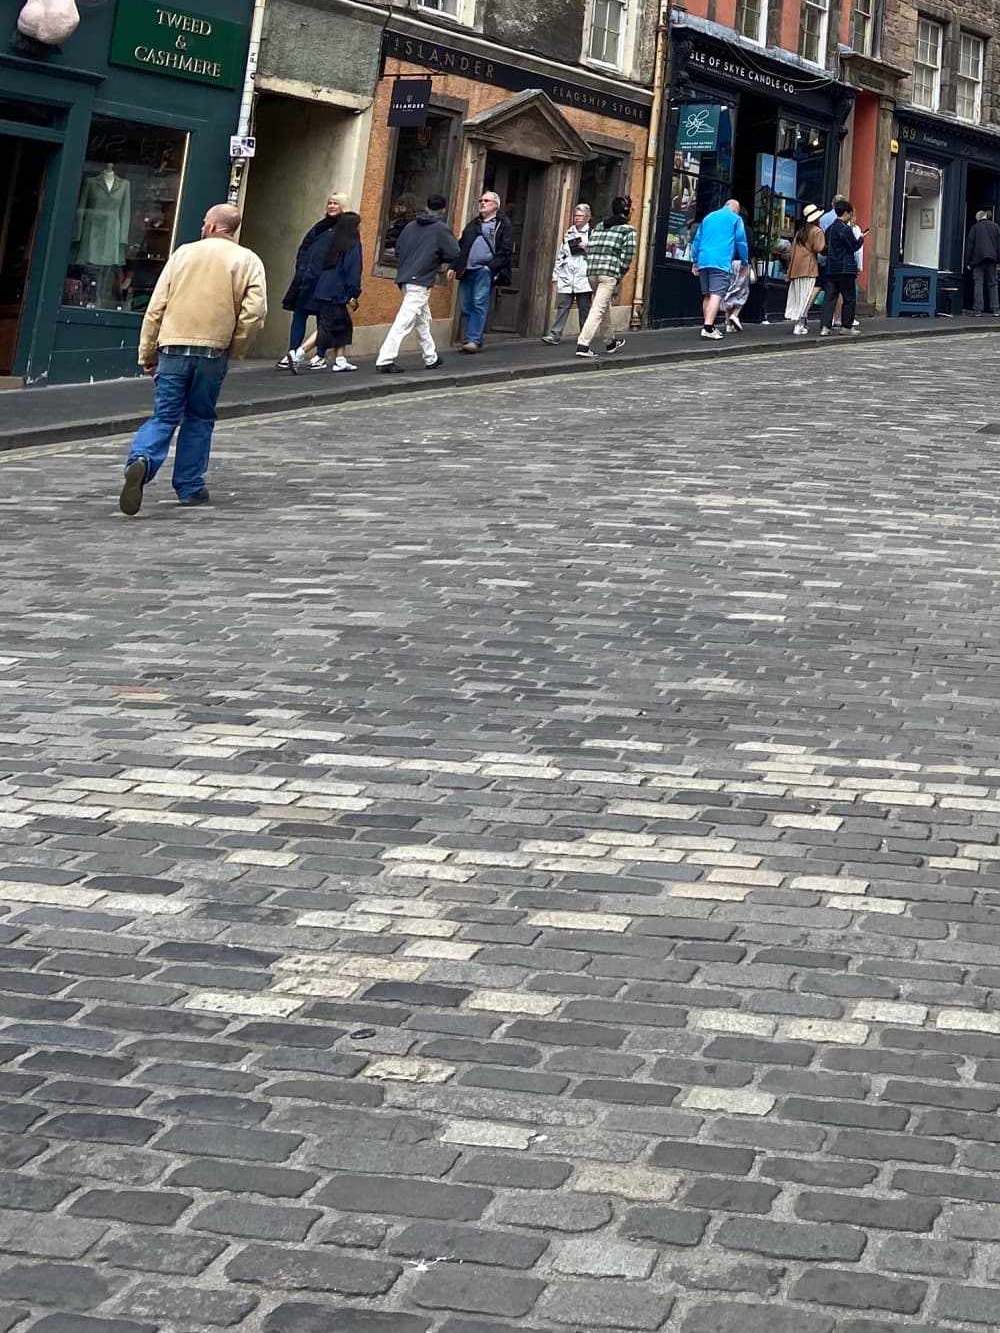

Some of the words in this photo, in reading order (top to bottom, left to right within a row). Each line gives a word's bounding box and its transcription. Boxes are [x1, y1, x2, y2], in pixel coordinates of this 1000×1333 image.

[156, 9, 212, 36] TWEED
[175, 34, 188, 51] &
[394, 37, 494, 78] ISLANDER
[134, 45, 221, 78] CASHMERE
[689, 51, 706, 63] SLE
[709, 56, 721, 68] OF
[723, 61, 745, 77] SKYE
[748, 70, 781, 90] CANDLE
[783, 84, 797, 94] CO.
[553, 86, 607, 109] FLAGSHIP
[612, 102, 644, 119] STORE
[902, 127, 917, 140] 89
